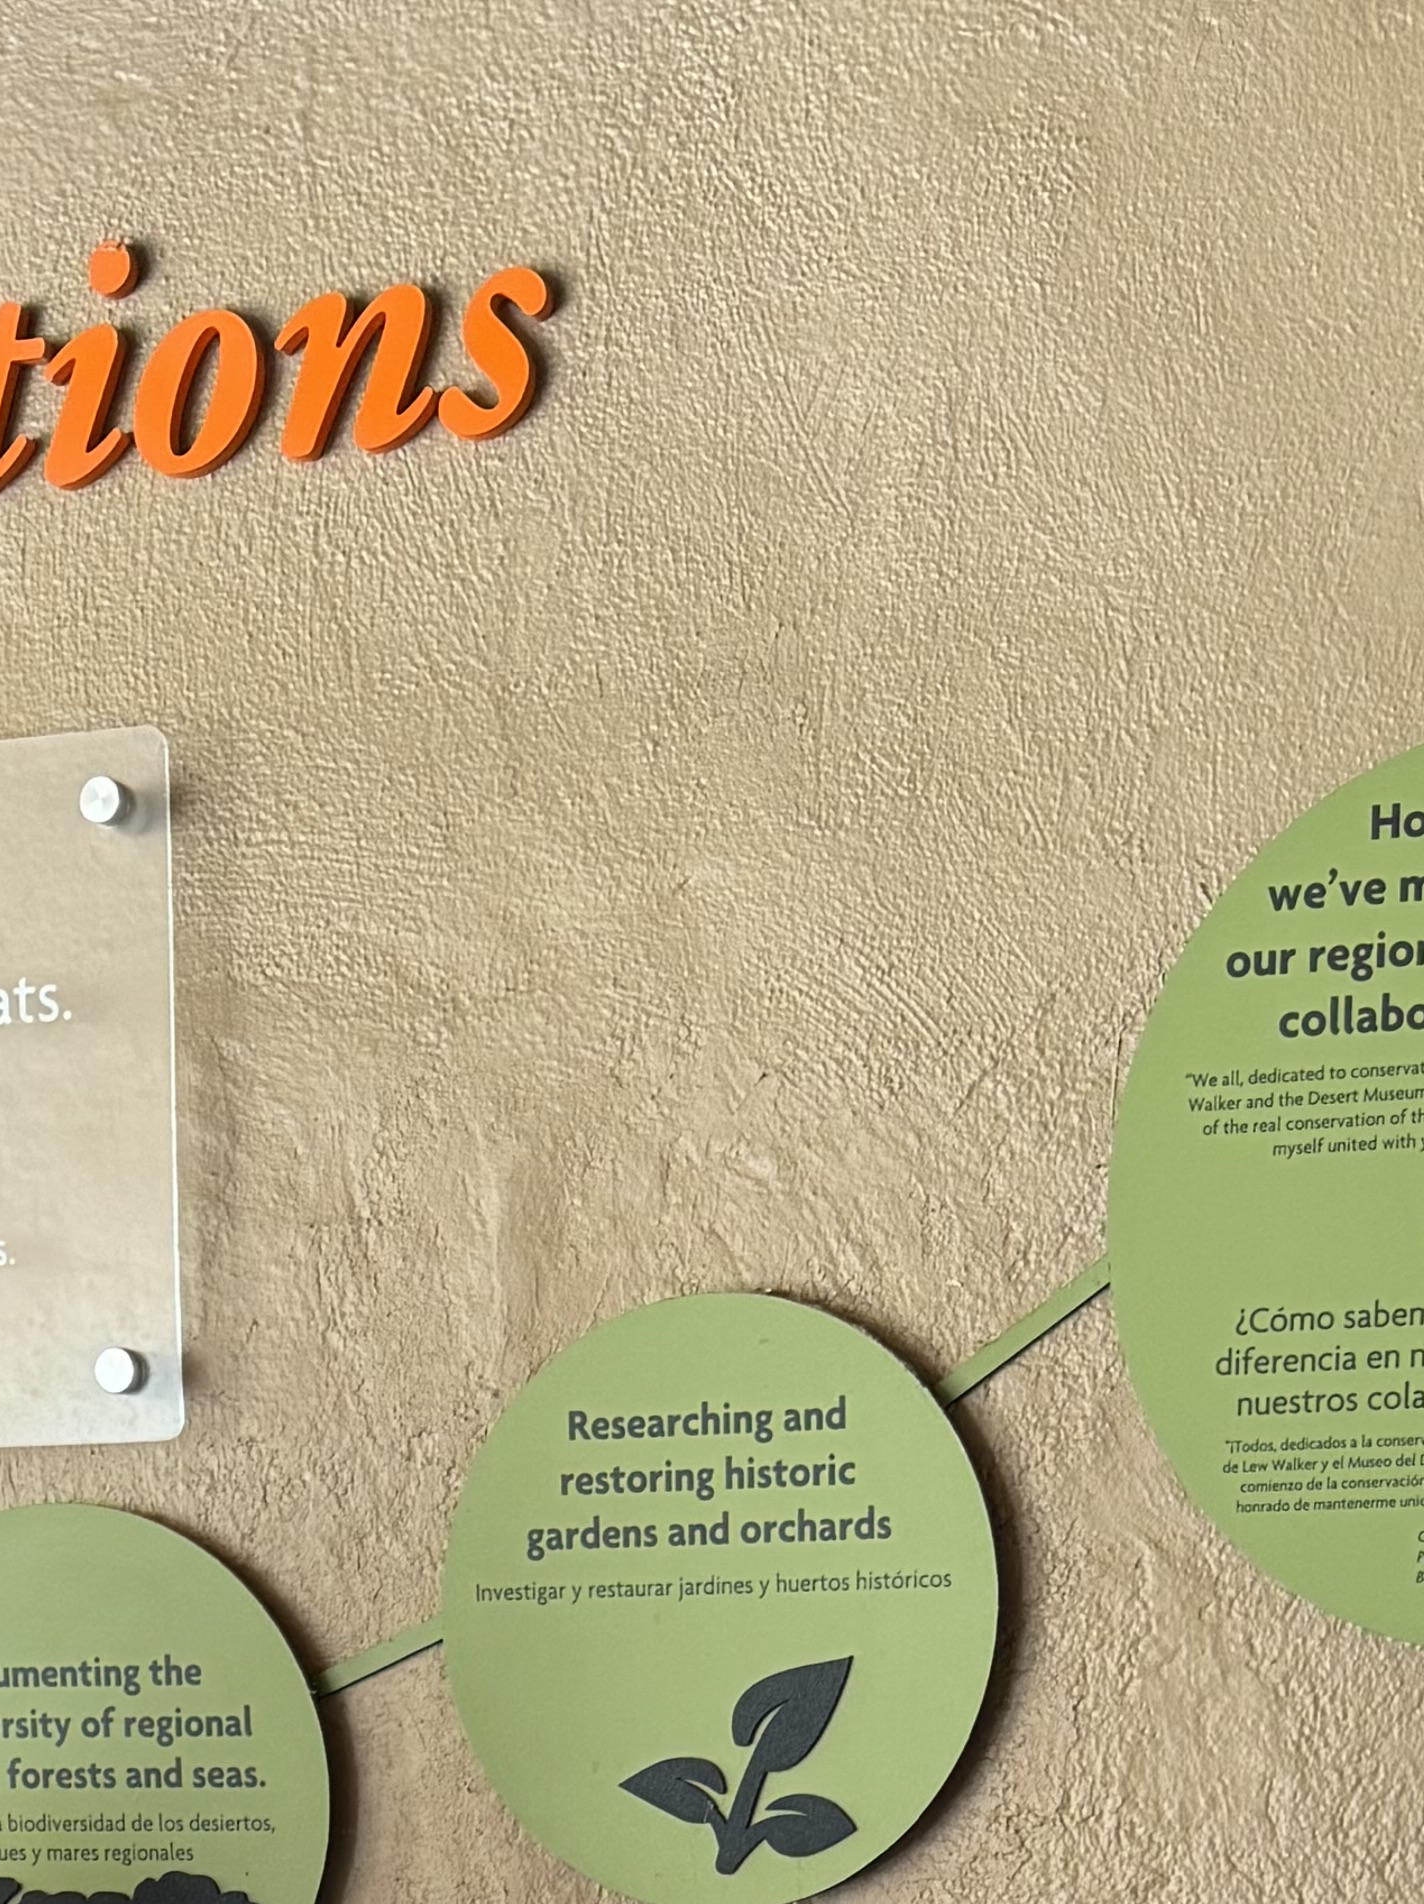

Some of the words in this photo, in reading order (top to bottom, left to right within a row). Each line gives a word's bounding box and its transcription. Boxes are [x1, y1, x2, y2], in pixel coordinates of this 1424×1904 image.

[1226, 948, 1297, 978] our
[1272, 1136, 1325, 1160] myself
[1327, 1134, 1378, 1153] united
[1382, 1132, 1416, 1150] with
[1235, 1306, 1335, 1336] ¿Cómo
[1215, 1345, 1357, 1376] diferencia
[1366, 1349, 1400, 1370] en
[568, 1401, 774, 1444] Researching
[783, 1394, 846, 1432] and
[560, 1459, 715, 1501] restoring
[725, 1453, 856, 1490] historic
[527, 1515, 658, 1561] gardens
[668, 1510, 730, 1547] and
[740, 1504, 892, 1544] orchards
[476, 1581, 566, 1606] Investigar
[571, 1585, 582, 1605] y
[588, 1581, 673, 1599] restaurar
[678, 1575, 754, 1602] jardines
[759, 1579, 770, 1600] y
[776, 1573, 850, 1593] huertos
[856, 1570, 952, 1591] históricos
[148, 1653, 202, 1686] the
[81, 1705, 116, 1738] of
[124, 1704, 253, 1747] regional
[6, 1757, 117, 1790] forests
[126, 1756, 183, 1789] and
[192, 1766, 266, 1789] seas.
[7, 1814, 126, 1833] biodiversidad
[131, 1814, 154, 1832] de
[158, 1814, 184, 1832] los
[189, 1814, 276, 1834] desiertos,
[31, 1848, 42, 1866] y
[46, 1848, 100, 1862] mares
[104, 1842, 194, 1867] regionales
